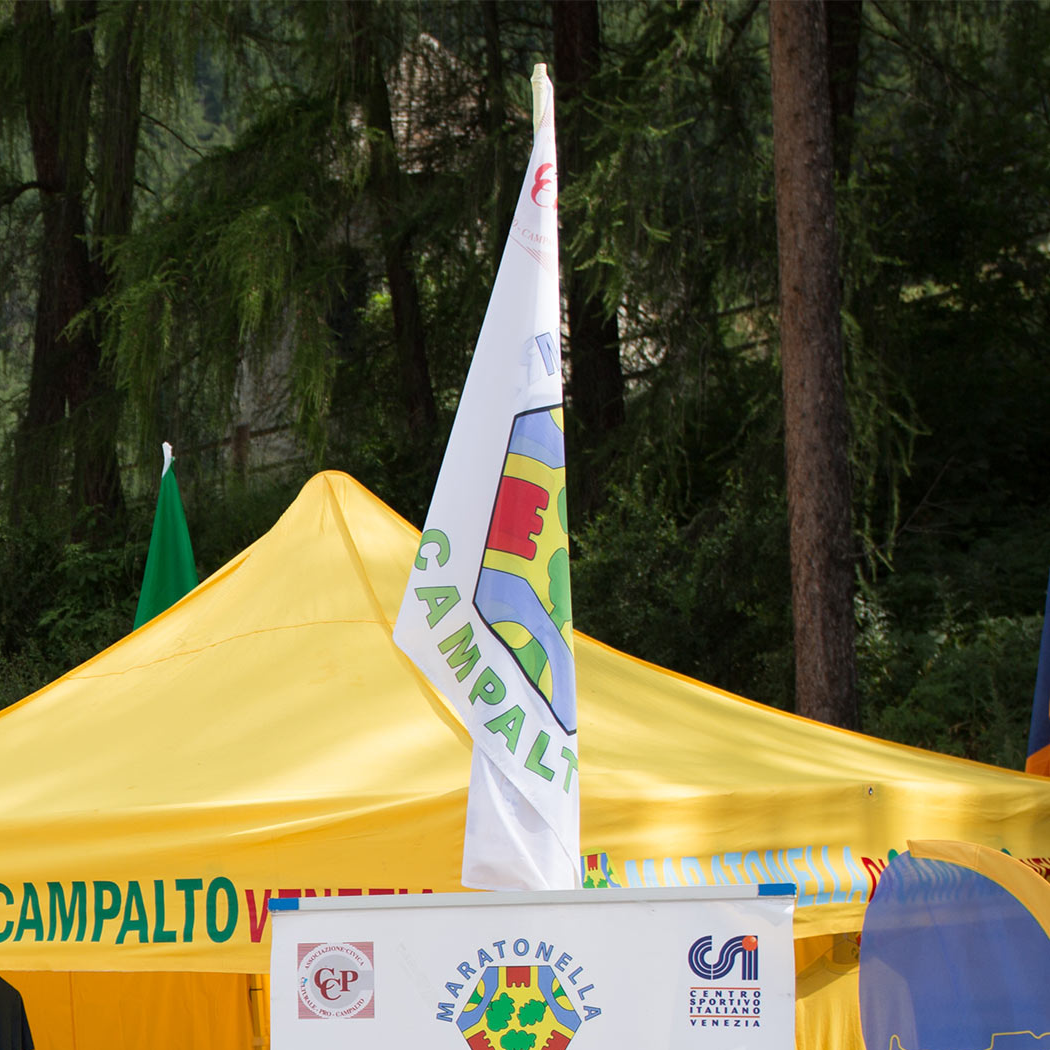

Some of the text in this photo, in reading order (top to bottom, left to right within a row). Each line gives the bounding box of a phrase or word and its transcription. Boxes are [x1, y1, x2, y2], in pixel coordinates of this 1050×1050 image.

[436, 938, 602, 1023] MARATONELLA
[690, 990, 761, 998] CENTRO
[690, 1019, 760, 1027] VENEZIA
